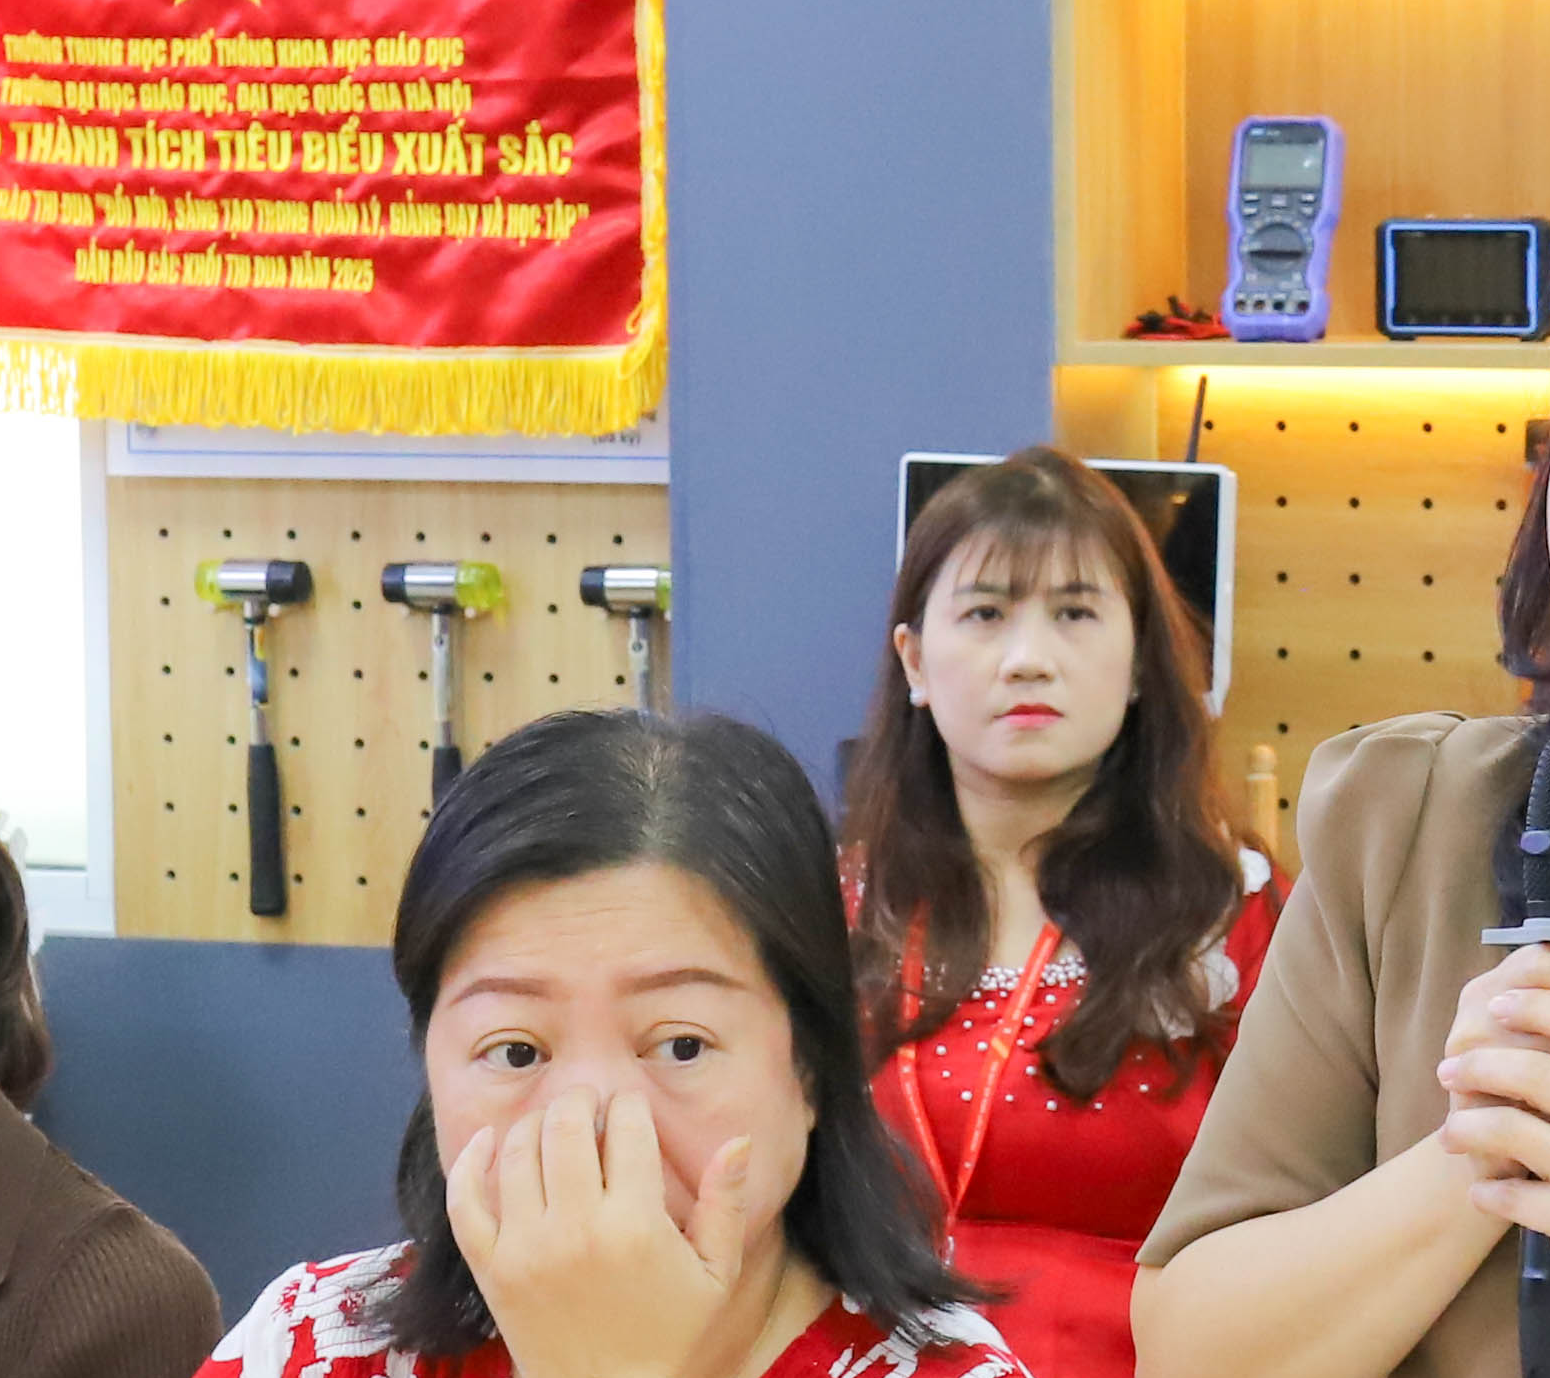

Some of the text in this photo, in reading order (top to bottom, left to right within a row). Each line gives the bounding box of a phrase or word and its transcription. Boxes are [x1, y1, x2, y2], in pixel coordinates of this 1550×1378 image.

[64, 36, 124, 66] TRUNG
[127, 37, 168, 72] HỌC
[216, 31, 275, 68] THÔNG
[276, 37, 329, 68] KHOA
[332, 37, 372, 72] HỌC
[375, 31, 422, 68] GIÁO
[425, 37, 465, 72] DỤC
[64, 80, 95, 115] ĐẠI
[98, 81, 136, 116] HỌC
[139, 77, 185, 112] GIÁO
[188, 82, 233, 117] DỤC,
[271, 83, 310, 117] HỌC
[312, 75, 365, 115] QUỐC
[368, 83, 402, 112] GIA
[404, 77, 433, 112] HÀ
[435, 77, 473, 117] NỘI
[9, 114, 119, 168] THÀNH
[125, 119, 206, 171] TÍCH
[213, 121, 293, 173] TIÊU
[301, 115, 385, 174] BIỂU
[392, 118, 486, 176] XUẤT
[498, 120, 574, 176] SẮC
[33, 189, 59, 224] THI
[174, 191, 219, 232] SÁNG
[481, 196, 503, 238] VÀ
[506, 203, 542, 247] HỌC
[147, 244, 181, 286] CÁC
[225, 254, 253, 290] THI
[331, 258, 375, 293] 2025
